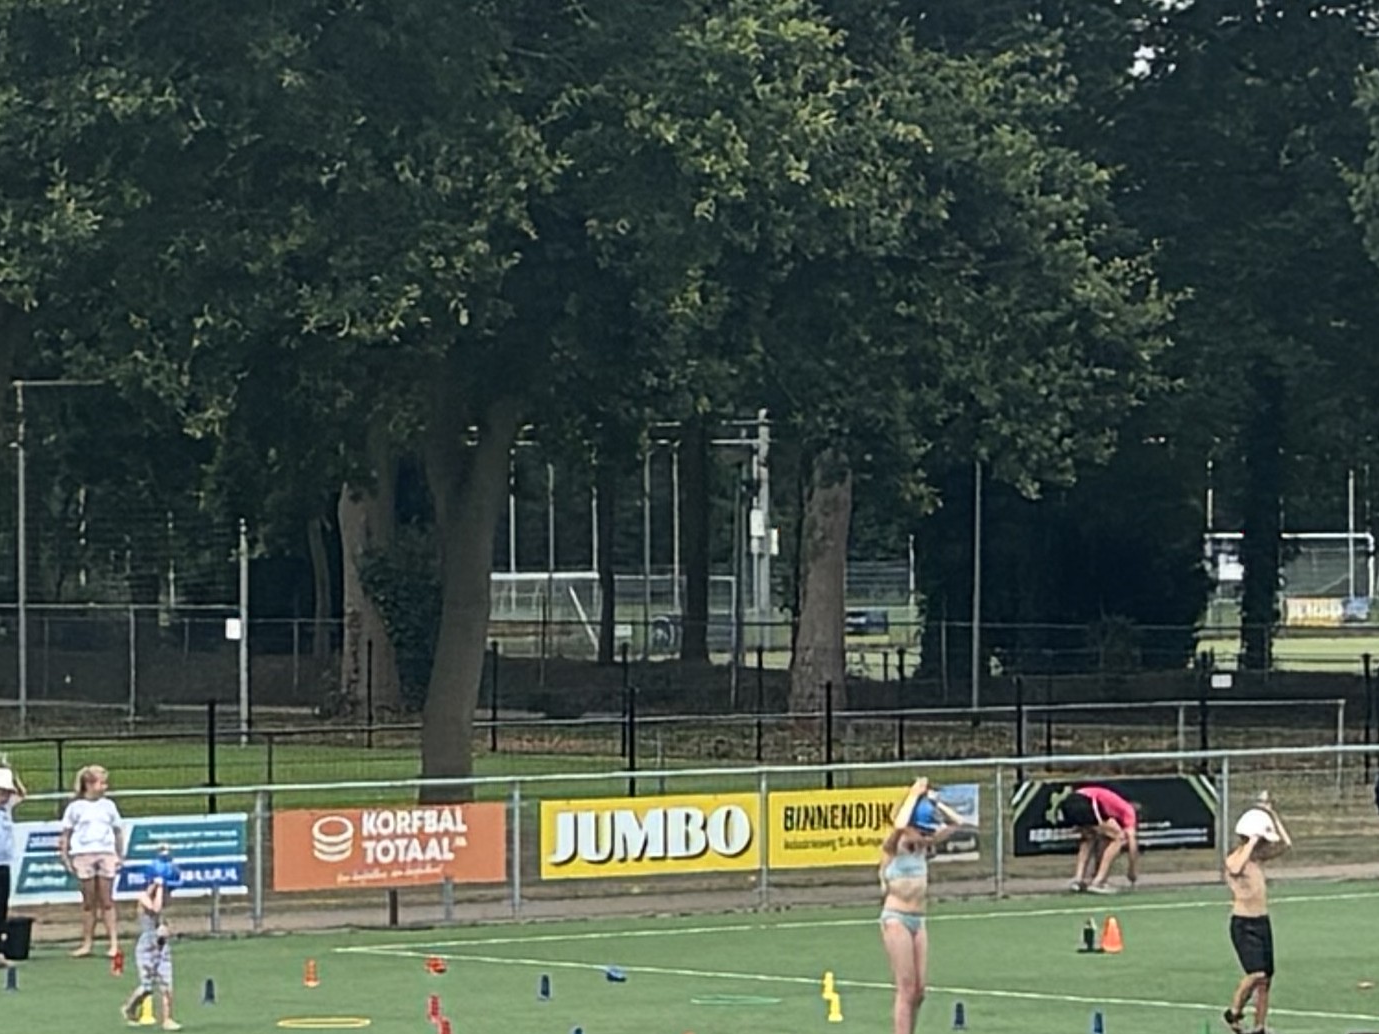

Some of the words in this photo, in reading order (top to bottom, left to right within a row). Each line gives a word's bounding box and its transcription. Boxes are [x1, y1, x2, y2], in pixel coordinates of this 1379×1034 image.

[361, 805, 469, 836] KORFBAL
[784, 801, 894, 831] BINNENDIJK
[548, 803, 753, 864] JUMBO
[361, 836, 455, 864] TOTAAL
